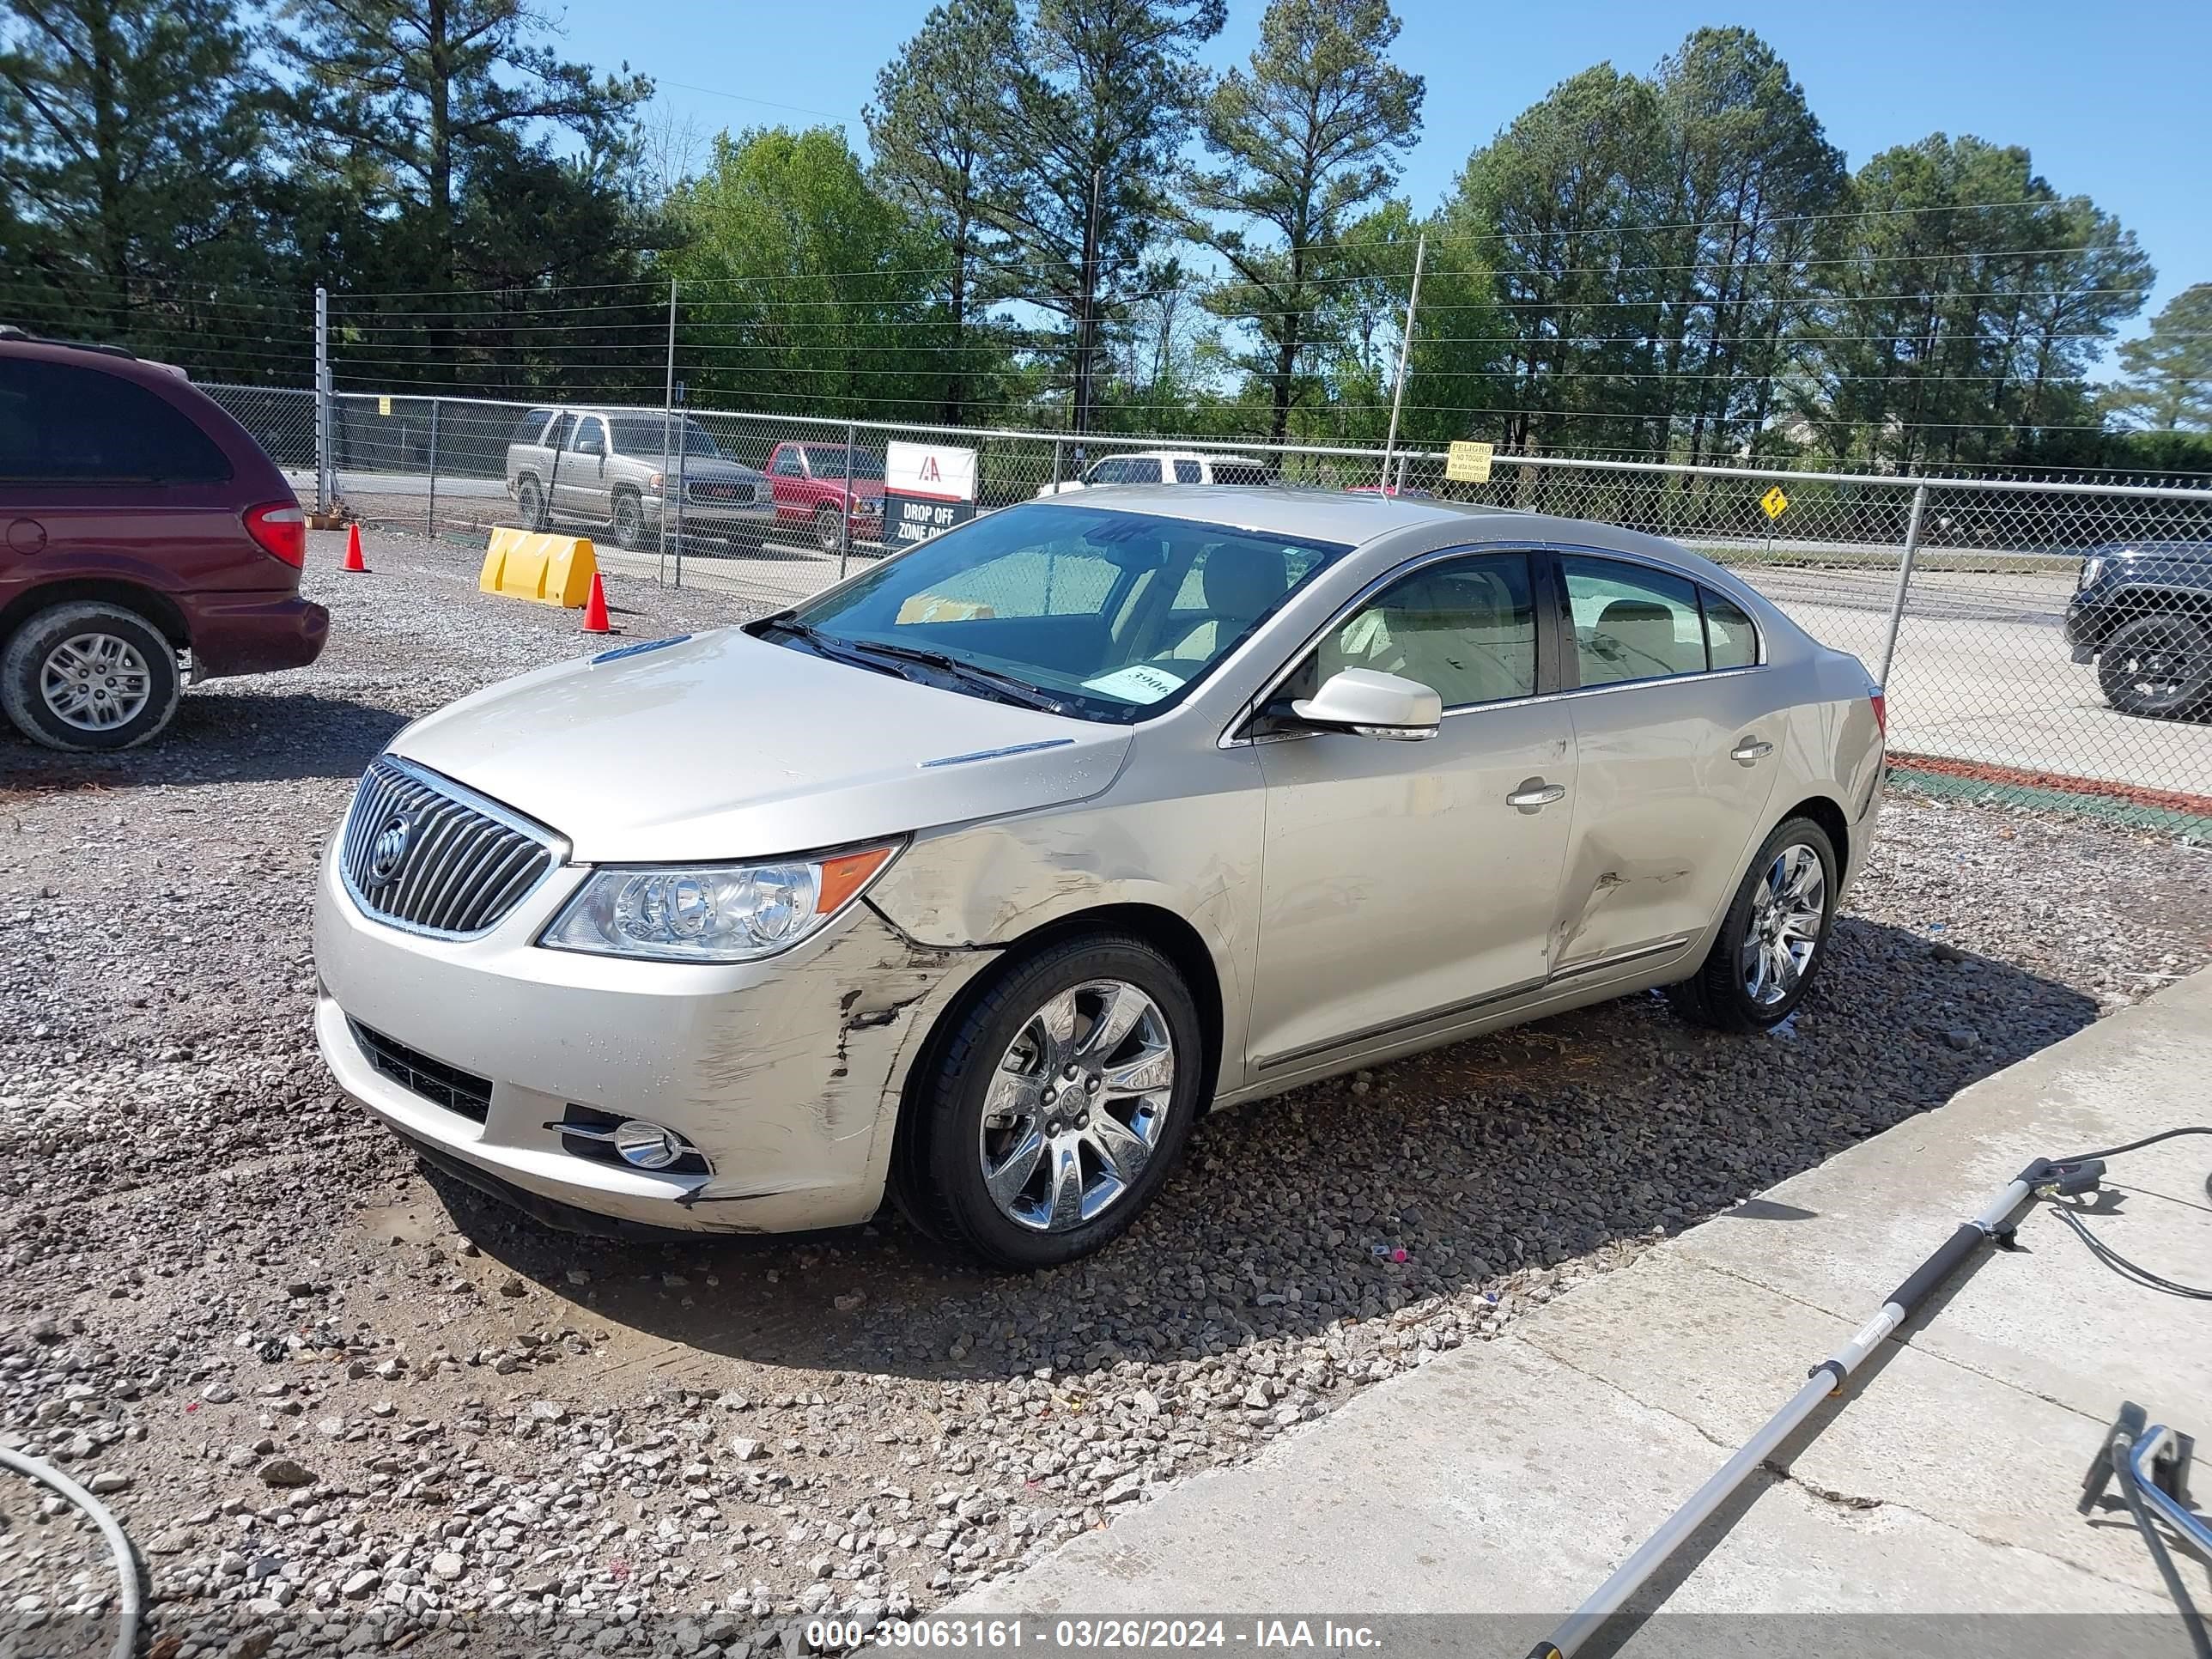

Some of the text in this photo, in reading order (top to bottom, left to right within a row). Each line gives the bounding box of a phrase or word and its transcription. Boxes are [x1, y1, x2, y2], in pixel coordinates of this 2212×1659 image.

[1452, 443, 1492, 453] PELIGRO
[1465, 454, 1484, 463] TOQUE
[904, 502, 955, 526] DROP OFF
[897, 521, 927, 542] ZONE
[1127, 672, 1171, 696] 3906
